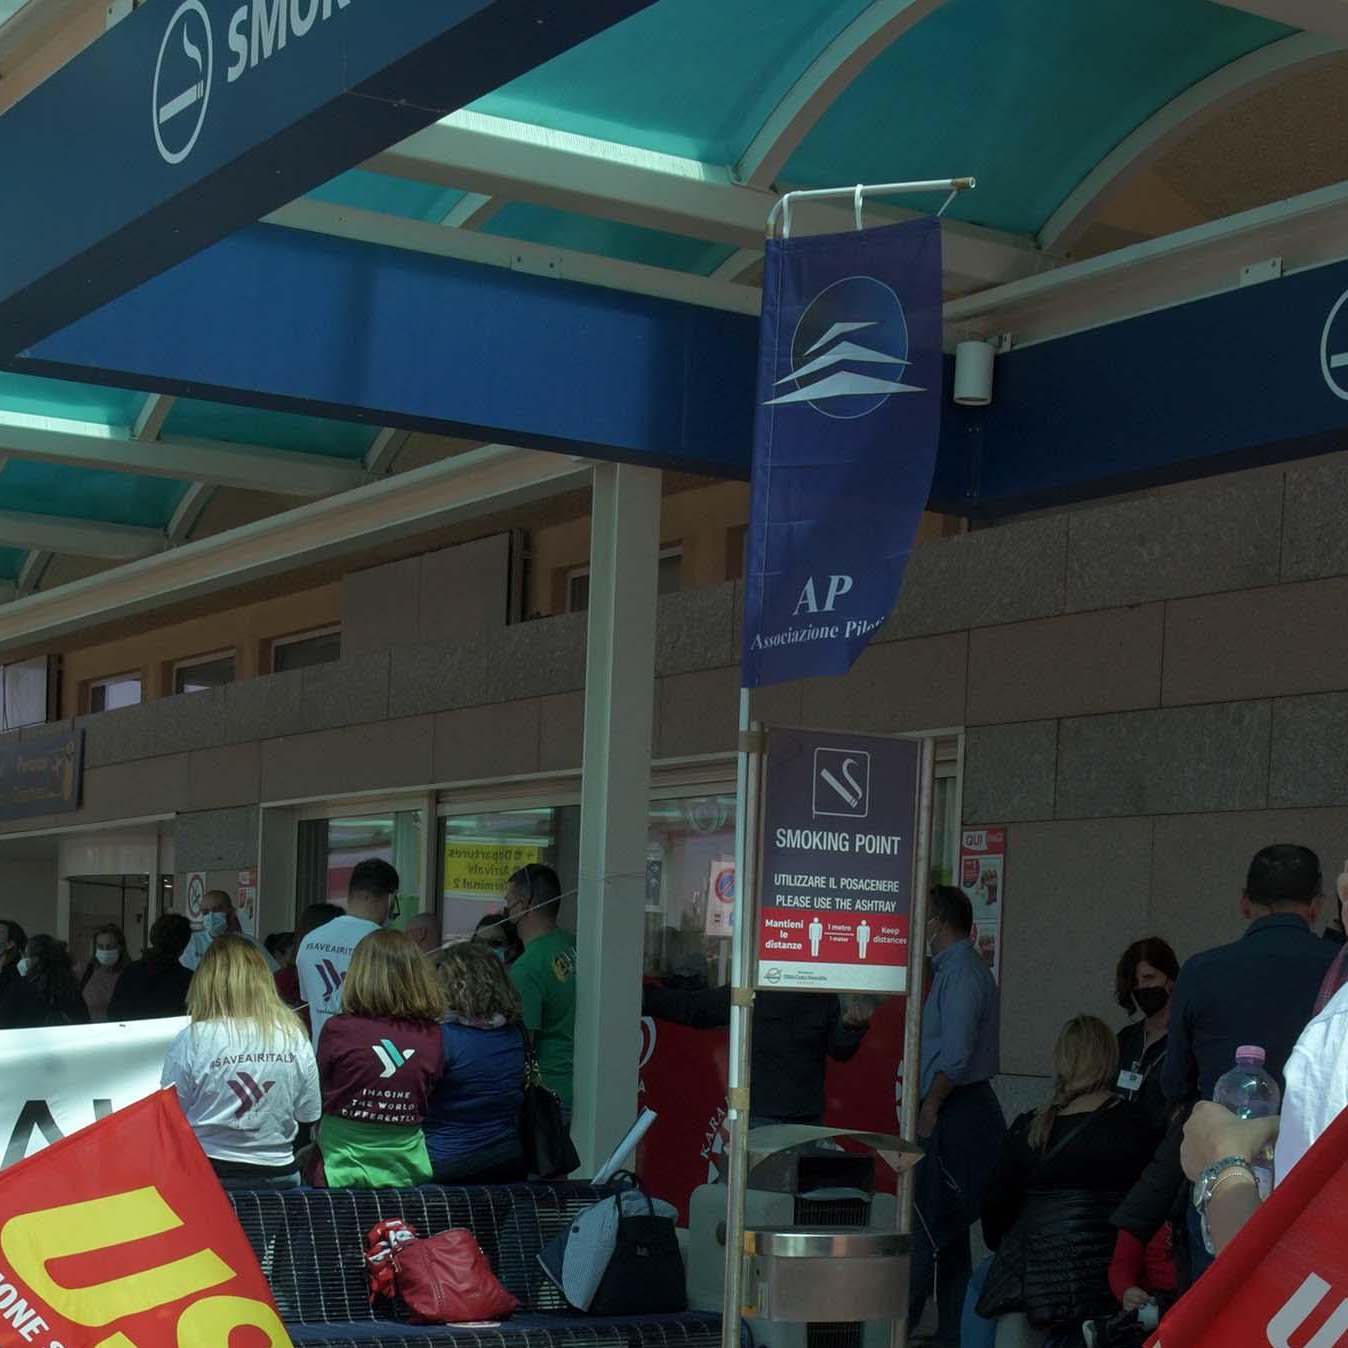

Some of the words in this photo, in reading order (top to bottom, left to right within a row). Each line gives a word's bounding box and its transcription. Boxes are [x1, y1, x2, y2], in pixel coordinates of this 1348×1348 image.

[792, 575, 853, 616] AP
[750, 624, 839, 650] Associazione
[775, 828, 850, 852] SMOKING
[855, 834, 902, 855] POINT
[774, 873, 826, 889] UTILIZZARE
[829, 877, 838, 889] IL
[840, 877, 900, 893] POSACENERE
[775, 894, 811, 908] PLEASE
[814, 897, 832, 910] USE
[835, 898, 852, 911] THE
[854, 899, 897, 913] ASHTRAY
[765, 919, 804, 930] Mantieni
[832, 924, 852, 932] metro
[780, 930, 788, 939] le
[881, 927, 900, 936] Keep
[765, 939, 803, 951] distanze
[873, 936, 907, 945] distances
[363, 1088, 411, 1099] IMAGINE
[352, 1099, 373, 1107] THE
[378, 1101, 415, 1111] WORLD
[342, 1108, 414, 1122] DIFFERENTLY
